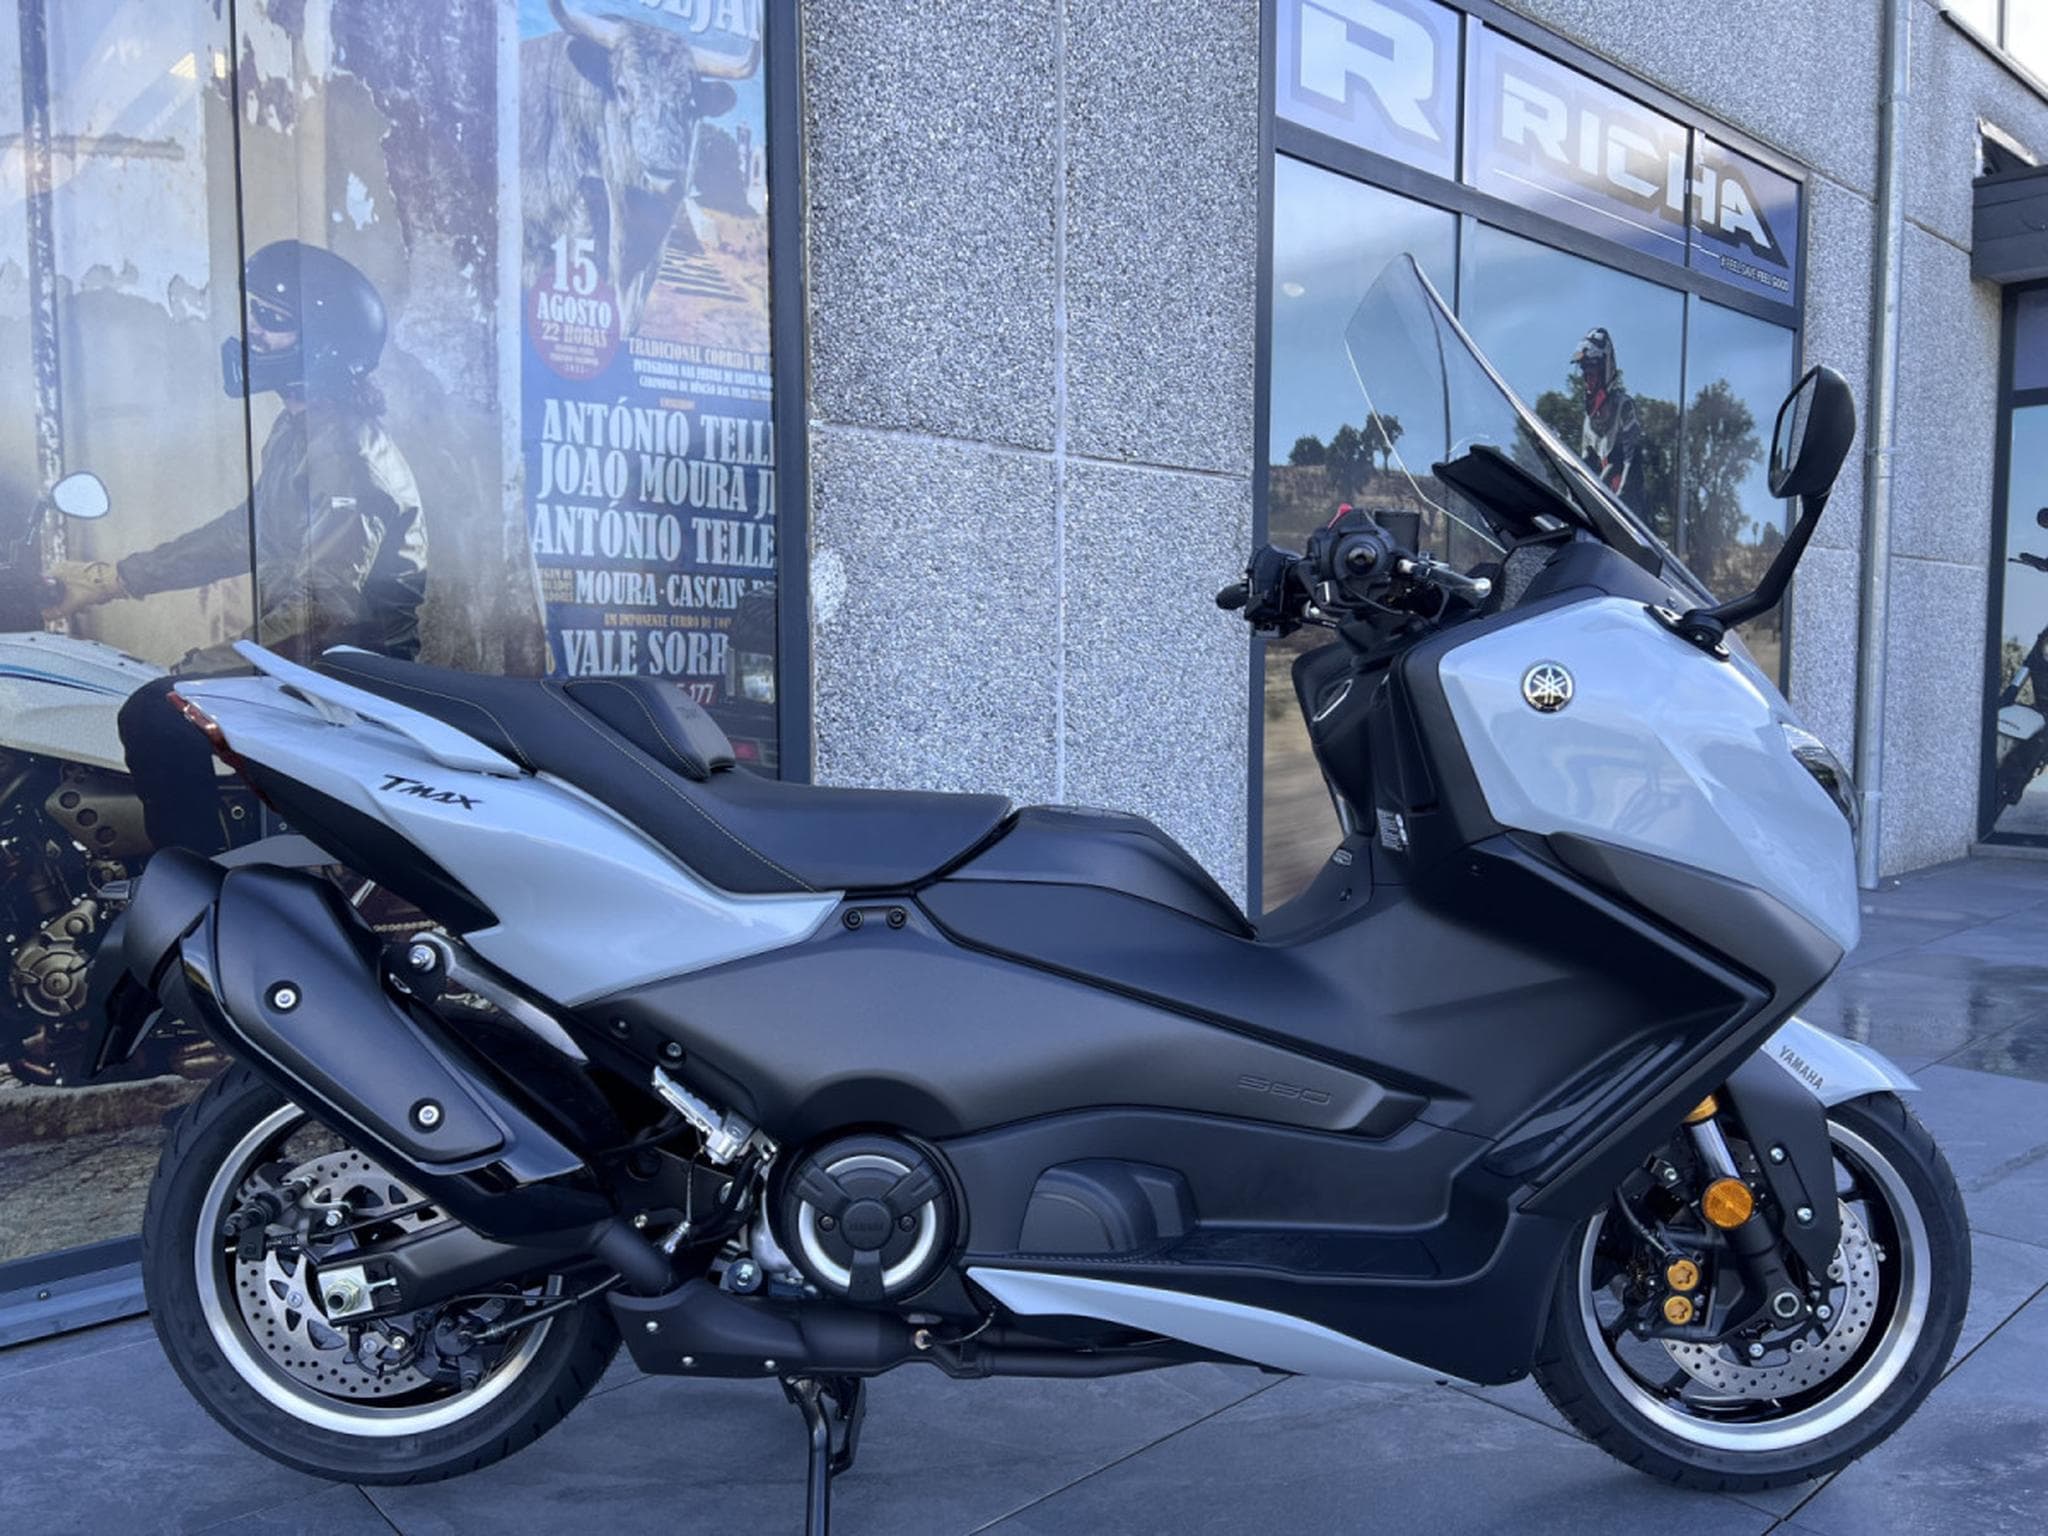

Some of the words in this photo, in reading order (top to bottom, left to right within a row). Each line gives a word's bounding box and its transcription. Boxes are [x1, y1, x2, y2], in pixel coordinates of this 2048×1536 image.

[1301, 0, 1441, 142] R
[1501, 73, 1772, 249] RICHA
[551, 234, 597, 296] 15
[536, 291, 613, 329] AGOSTO
[541, 321, 561, 341] 22
[563, 324, 609, 349] HORAS
[543, 397, 690, 457] ANTÓNIO
[639, 454, 748, 514] MOURA
[532, 500, 682, 563] ANTÓNIO
[561, 629, 639, 677] VALE
[1779, 1045, 1825, 1090] YAMAHA
